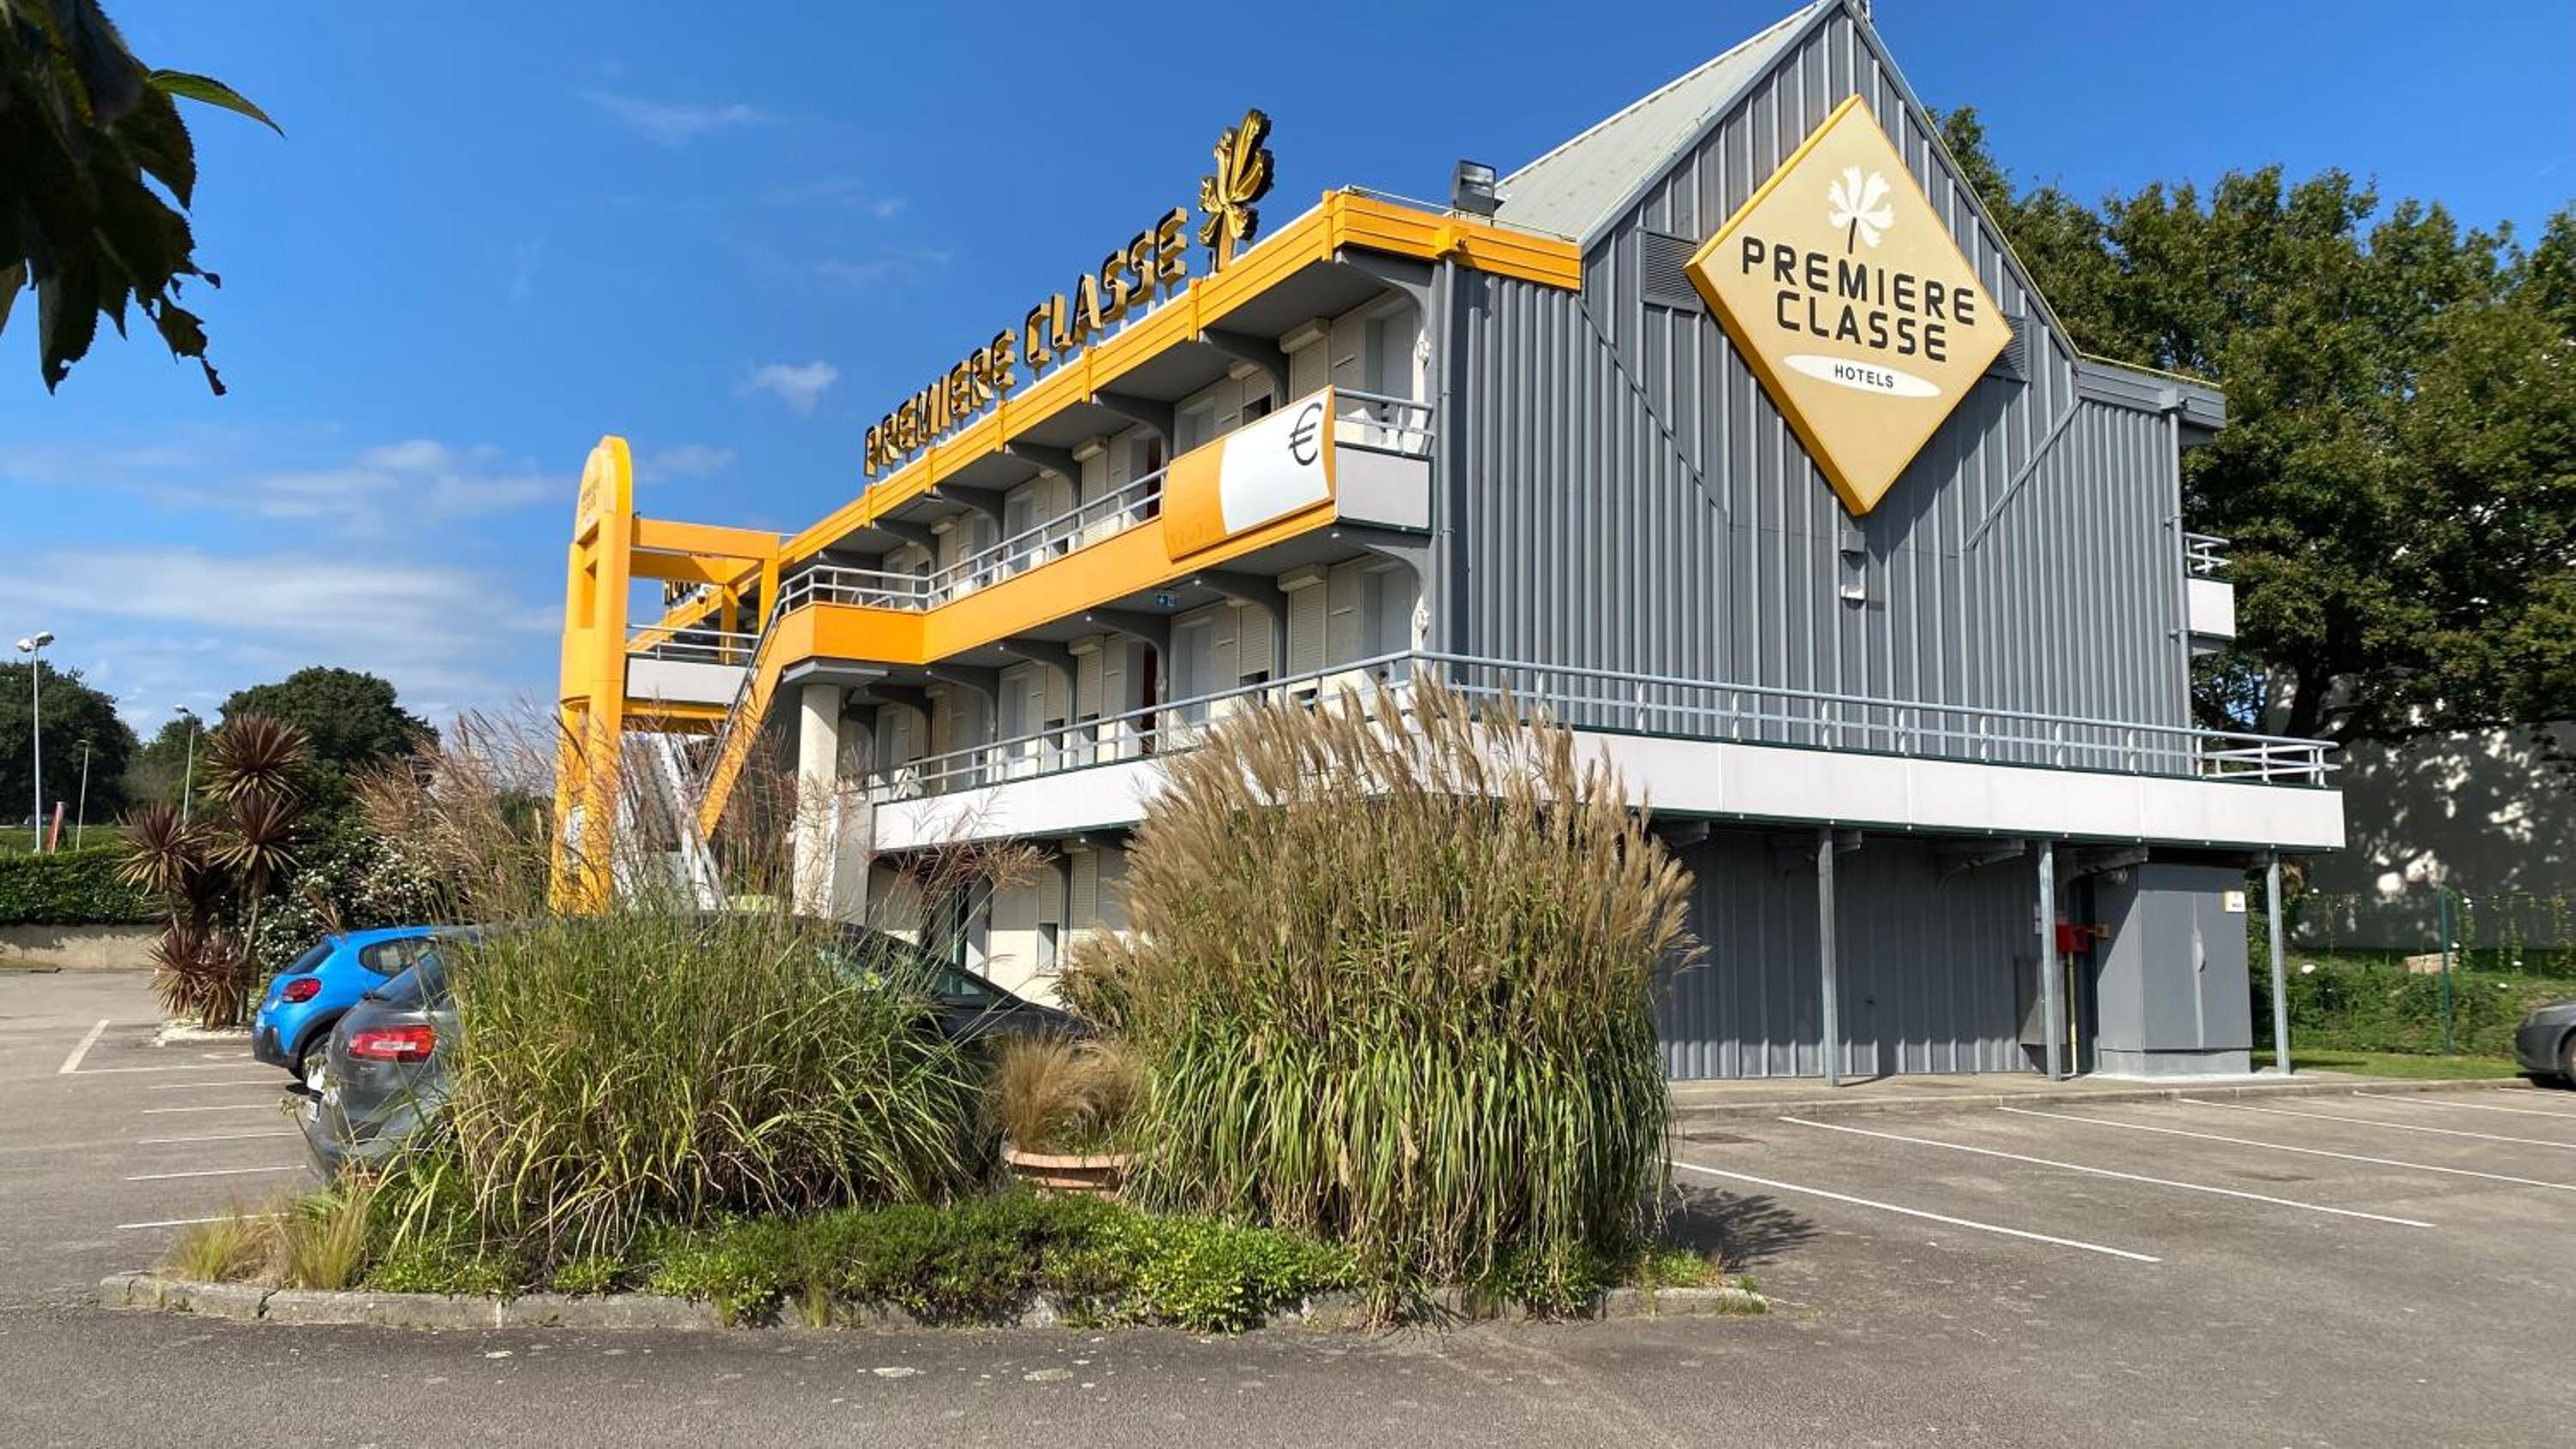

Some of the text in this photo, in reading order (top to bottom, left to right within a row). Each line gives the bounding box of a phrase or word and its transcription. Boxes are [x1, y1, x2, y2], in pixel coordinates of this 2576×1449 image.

[1741, 236, 1975, 325] PREMIERE
[865, 206, 1189, 476] PREMIERE CLASSE
[1777, 289, 1947, 362] CLASSE
[1833, 363, 1895, 389] HOTELS
[1287, 401, 1323, 466] €
